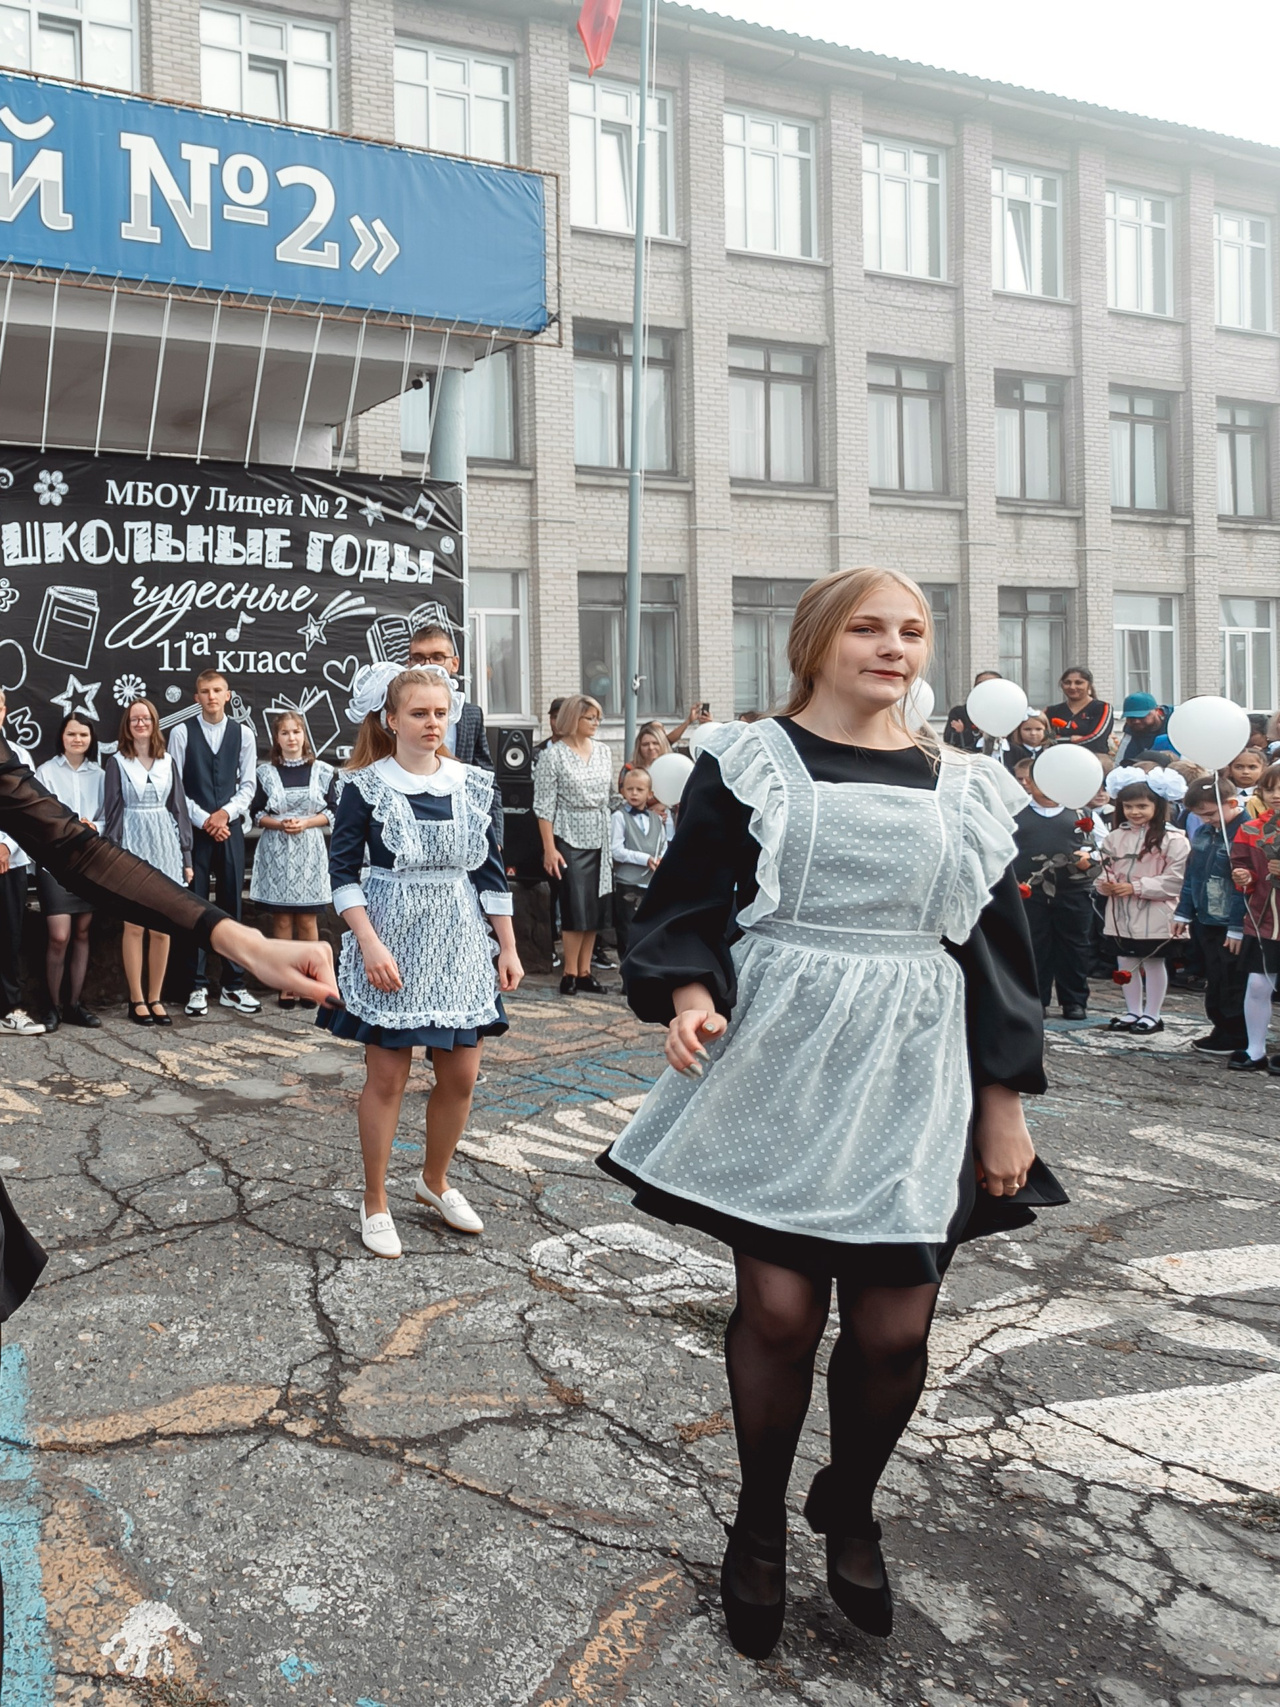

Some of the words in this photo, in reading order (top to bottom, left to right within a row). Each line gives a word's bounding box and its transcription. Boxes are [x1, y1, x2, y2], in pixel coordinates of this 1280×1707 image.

[120, 131, 401, 276] №2»
[105, 479, 201, 516] МБОУ
[205, 486, 294, 518] Лицей
[1, 519, 293, 570] ШКОЛЬНЫЕ
[306, 531, 435, 585] ГОДЫ
[104, 576, 319, 650] чудесные
[216, 649, 308, 674] класс
